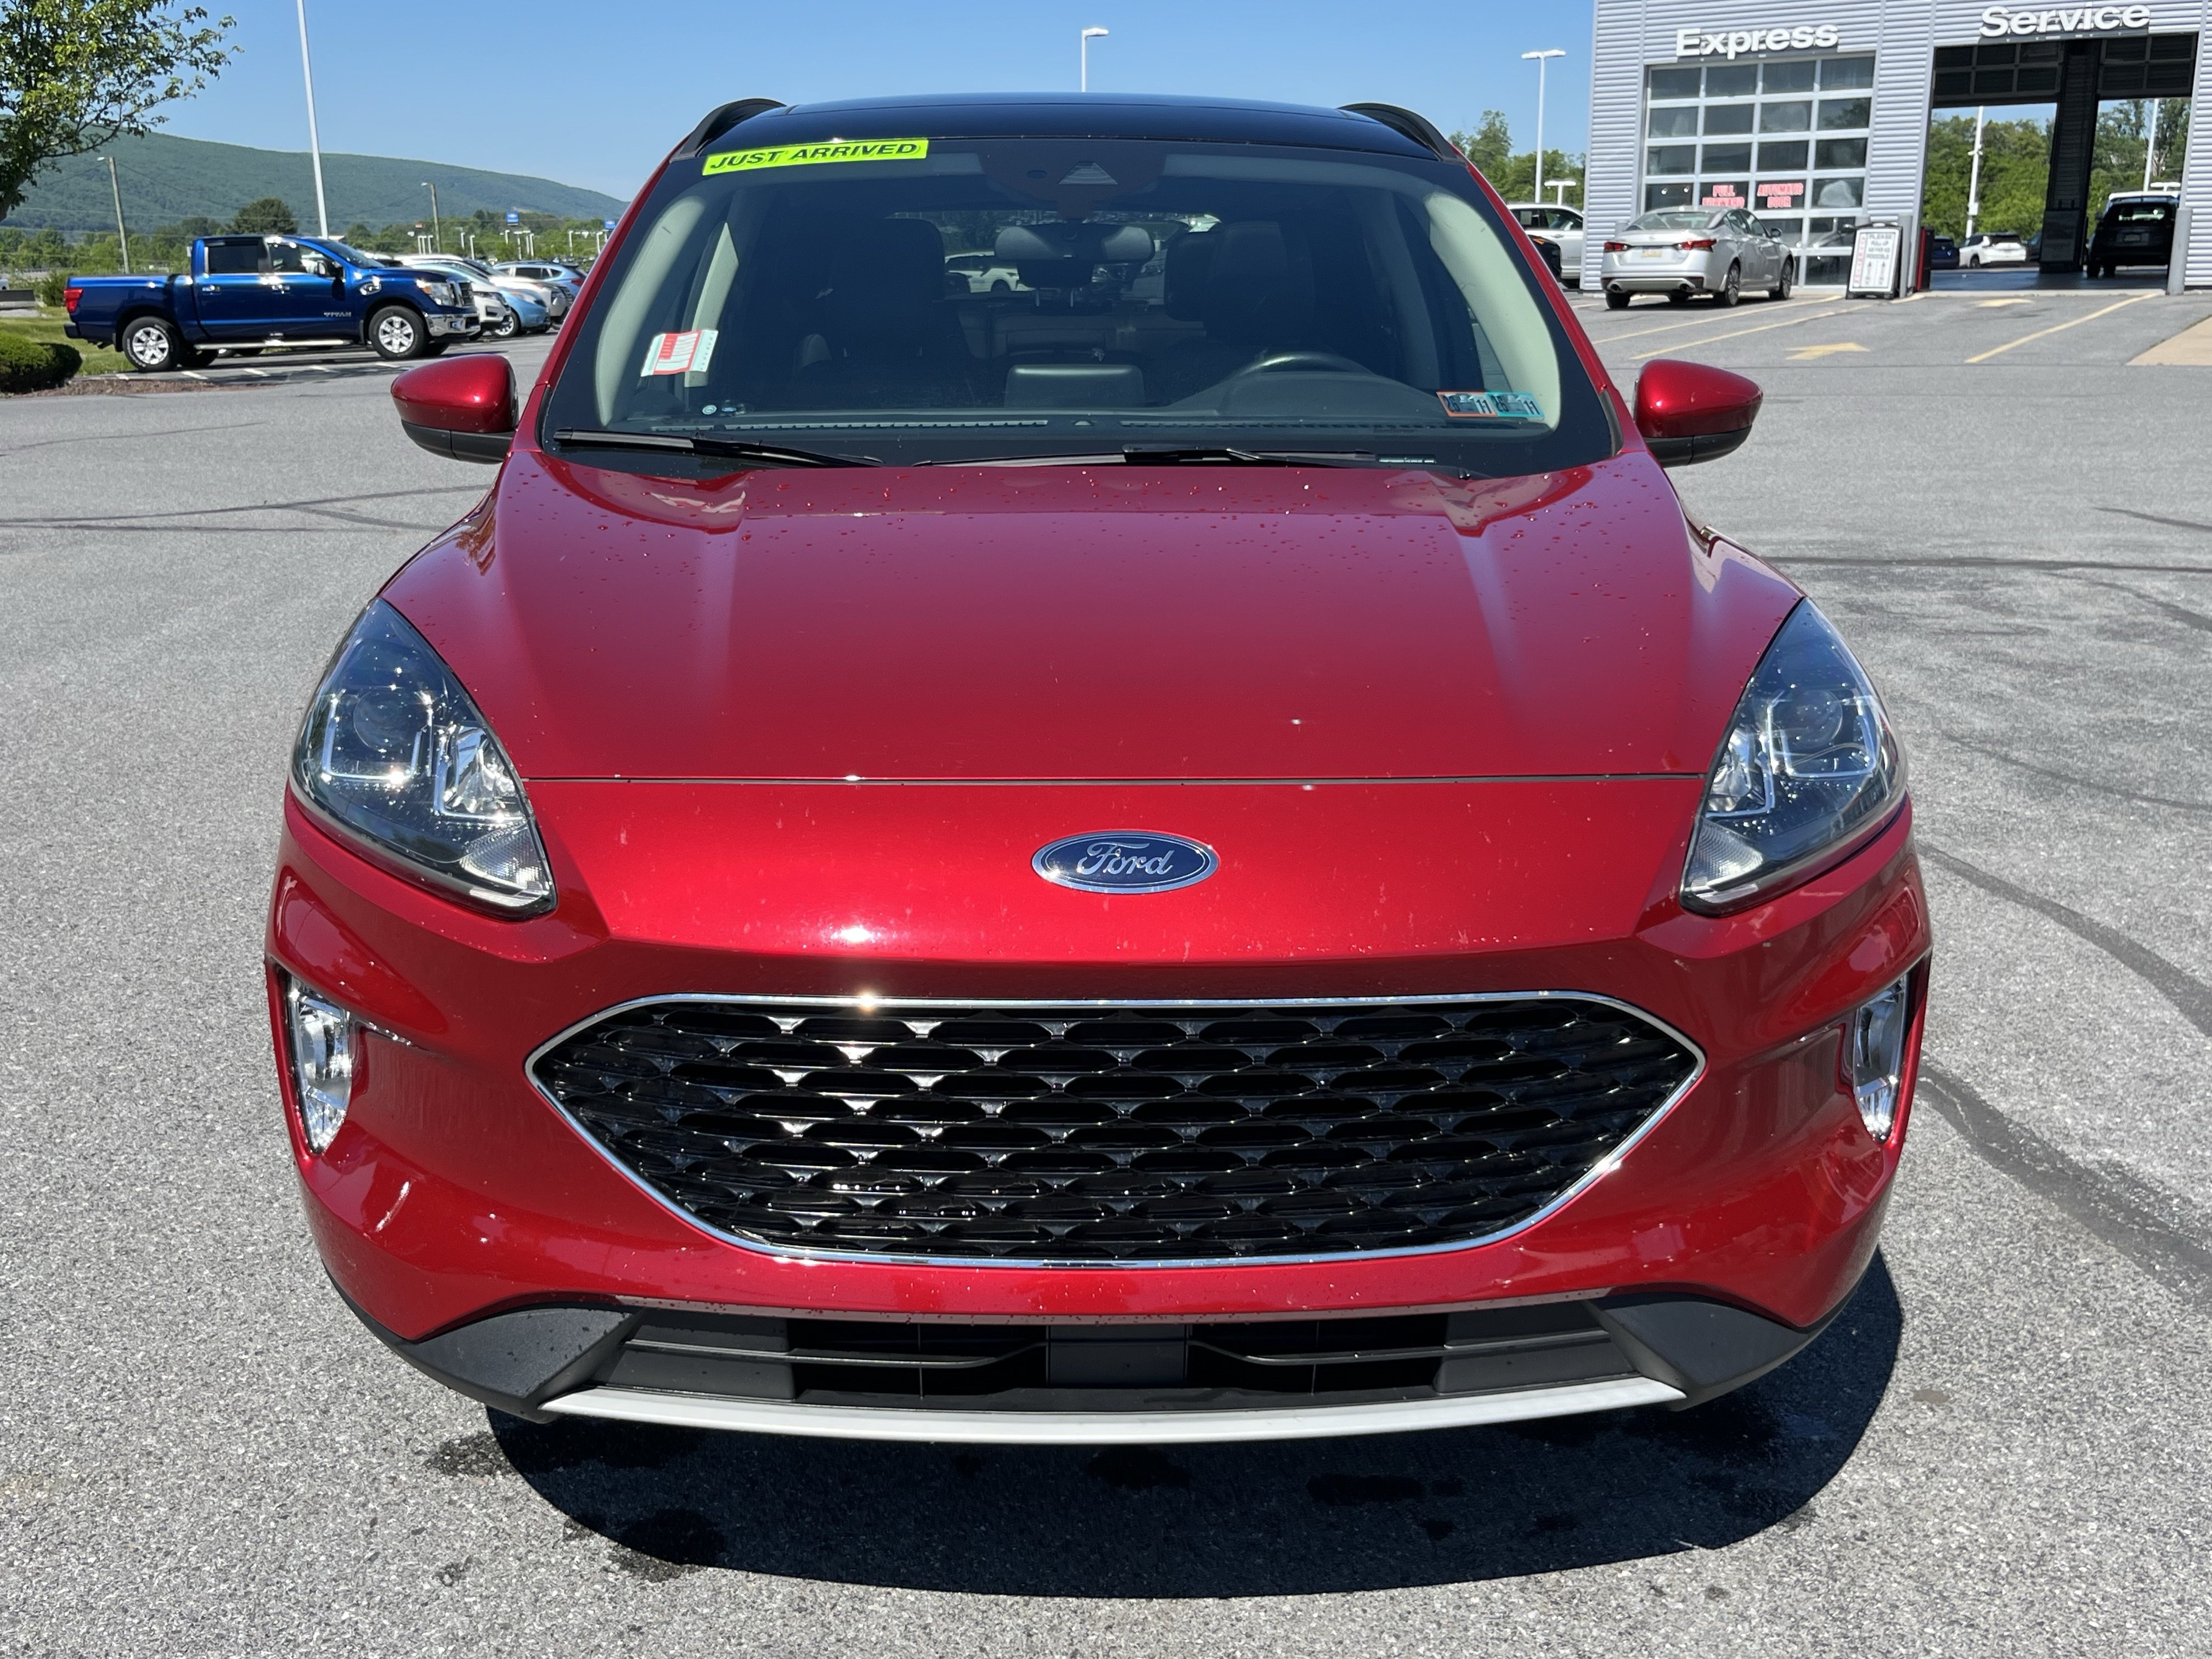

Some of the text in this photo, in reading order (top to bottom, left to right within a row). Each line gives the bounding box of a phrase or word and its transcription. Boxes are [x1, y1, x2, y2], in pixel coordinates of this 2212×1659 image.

[1979, 2, 2151, 37] Service
[1675, 24, 1839, 59] Express
[710, 143, 919, 169] JUST ARRIVED
[1712, 184, 1736, 198] PULL
[1757, 183, 1804, 196] AUTOMATIC
[1767, 196, 1792, 208] DOOR
[1076, 842, 1175, 875] Ford
